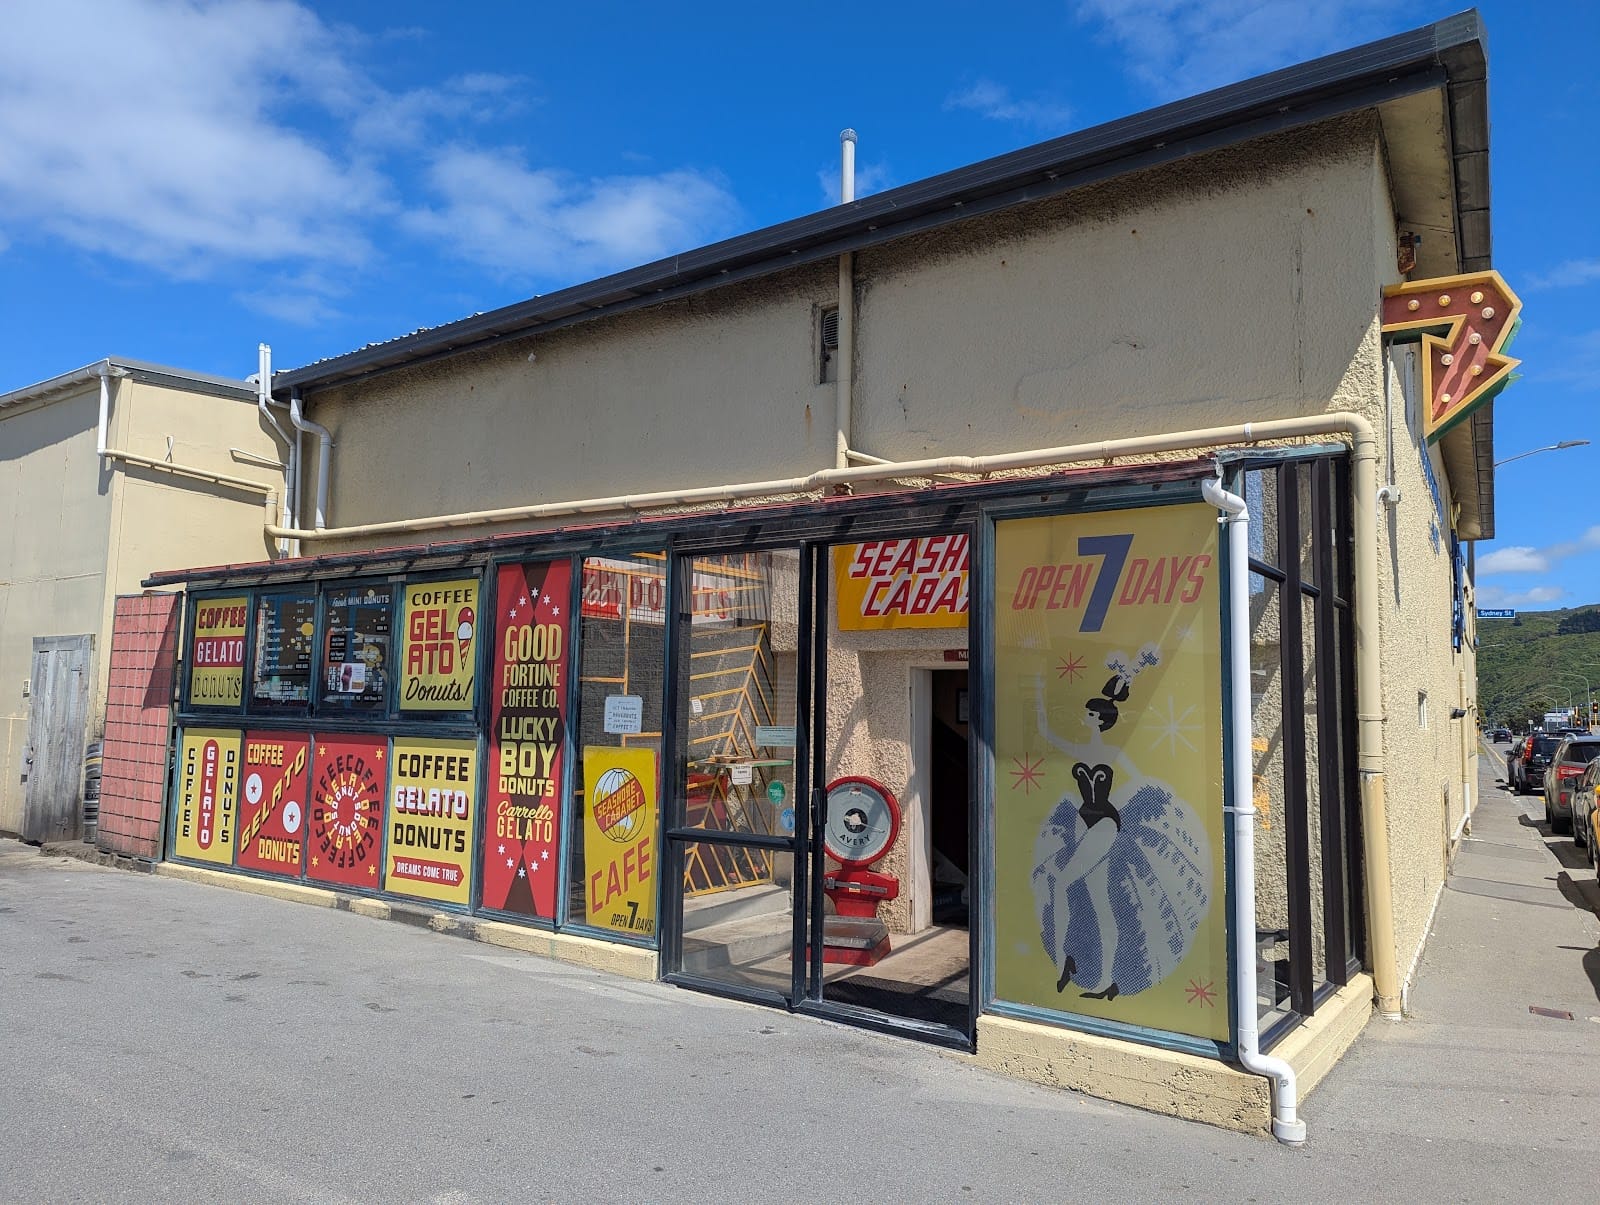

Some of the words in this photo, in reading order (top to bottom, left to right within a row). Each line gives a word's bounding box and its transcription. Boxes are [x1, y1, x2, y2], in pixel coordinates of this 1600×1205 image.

[412, 589, 472, 606] COFFEE
[1012, 563, 1094, 610] OPEN
[1078, 534, 1135, 633] 7
[1118, 554, 1212, 606] DAYS
[199, 606, 246, 629] COFFEE
[410, 609, 454, 641] GEL
[197, 641, 243, 663] GELATO
[504, 624, 562, 662] GOOD
[408, 643, 454, 675] ATO
[194, 674, 241, 698] DONUTS
[406, 676, 474, 701] Donuts!
[503, 664, 561, 687] FORTUNE
[502, 688, 538, 708] COFFEE
[542, 689, 559, 708] CO.
[501, 717, 558, 741] LUCKY
[247, 743, 284, 767] COFFEE
[398, 753, 469, 781] COFFEE
[500, 741, 557, 778] BOY
[182, 748, 196, 838] COFFEE
[200, 746, 216, 844] GELATO
[220, 750, 235, 843] DONUTS
[241, 745, 306, 853] GELATO
[498, 777, 555, 797] DONUTS
[598, 780, 636, 819] SEASHORE
[394, 785, 469, 820] GELATO
[497, 800, 554, 819] Carrello
[605, 791, 641, 828] CABARET
[394, 823, 465, 852] DONUTS
[497, 816, 553, 843] GELATO
[840, 834, 871, 846] AVERY
[258, 836, 300, 864] DONUTS
[396, 862, 421, 876] DREAMS
[422, 866, 440, 879] COME
[442, 868, 458, 881] TRUE
[591, 836, 651, 914] CAFE
[610, 914, 628, 928] OPEN
[627, 901, 639, 929] 7
[635, 917, 653, 932] DAYS
